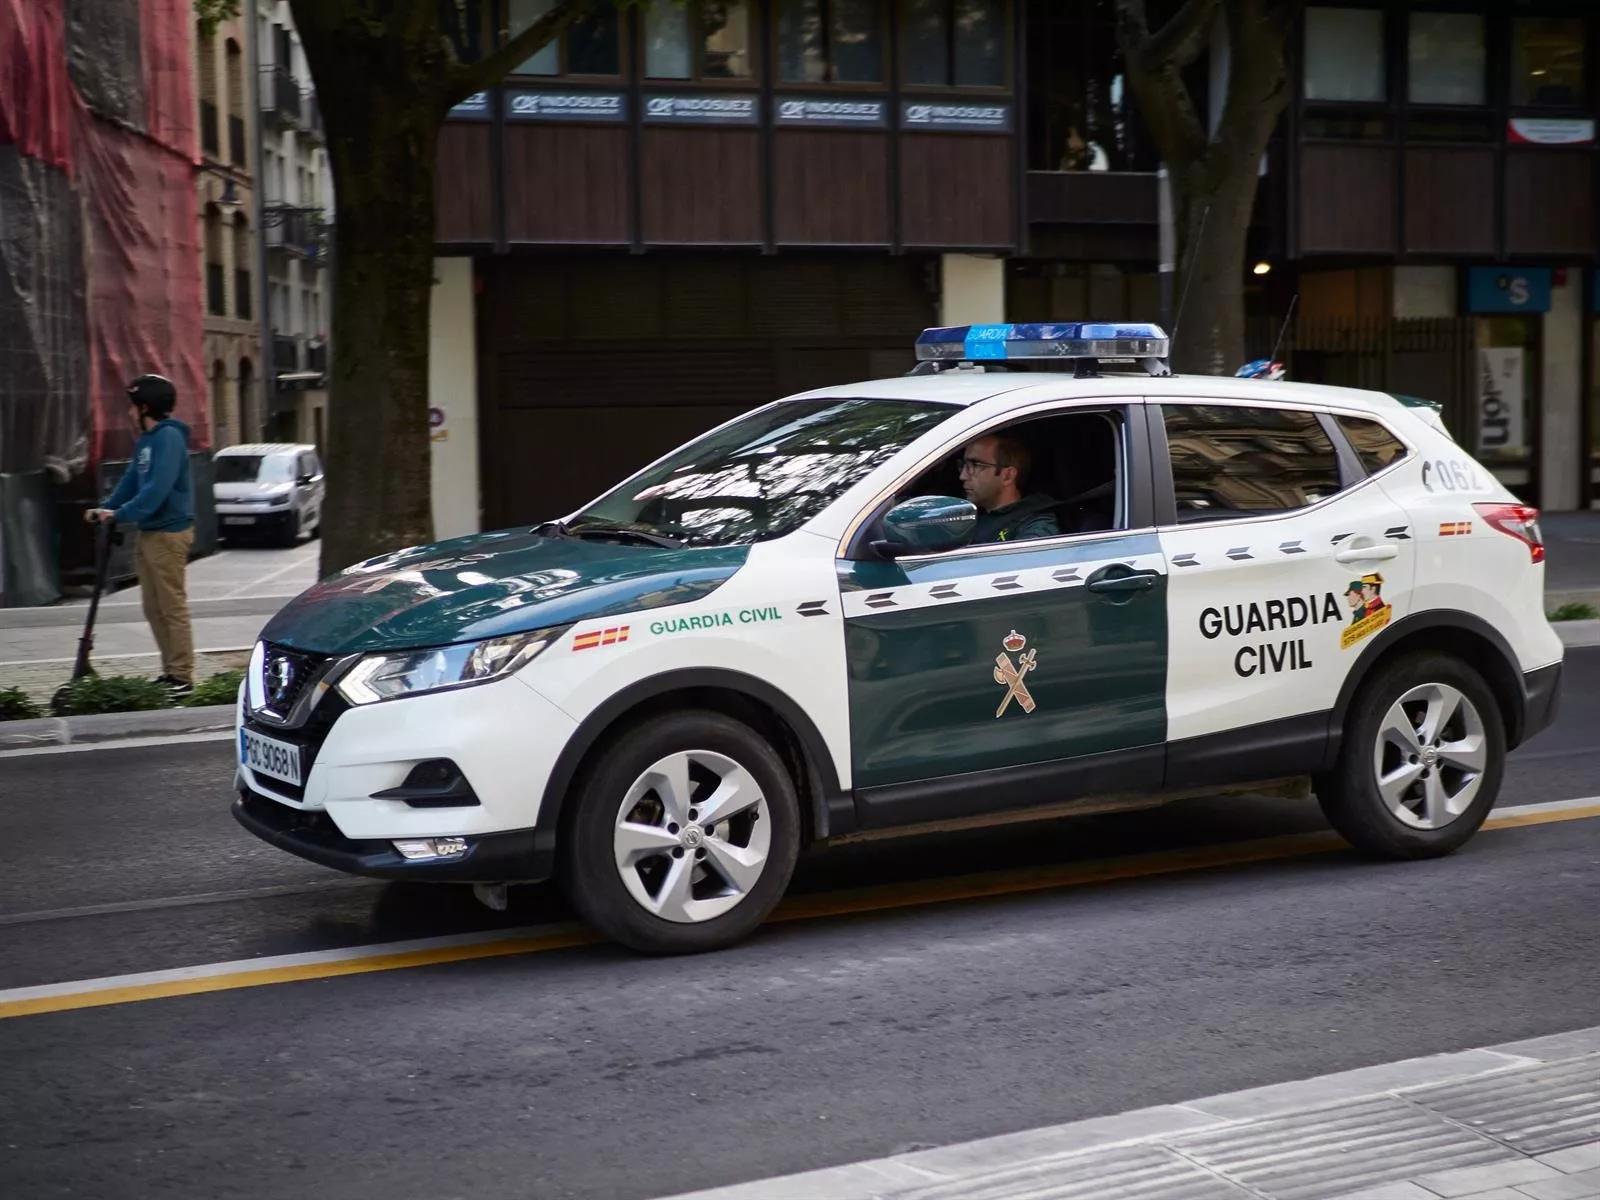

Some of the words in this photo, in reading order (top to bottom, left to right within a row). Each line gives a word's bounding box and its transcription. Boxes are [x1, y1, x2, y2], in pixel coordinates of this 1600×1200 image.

[967, 328, 1007, 340] GUARDIA
[1435, 460, 1483, 490] 062
[650, 612, 733, 635] GUARDIA
[739, 607, 782, 624] CIVIL
[1199, 592, 1343, 639] GUARDIA
[1234, 639, 1313, 678] CIVIL
[262, 742, 289, 776] 9068
